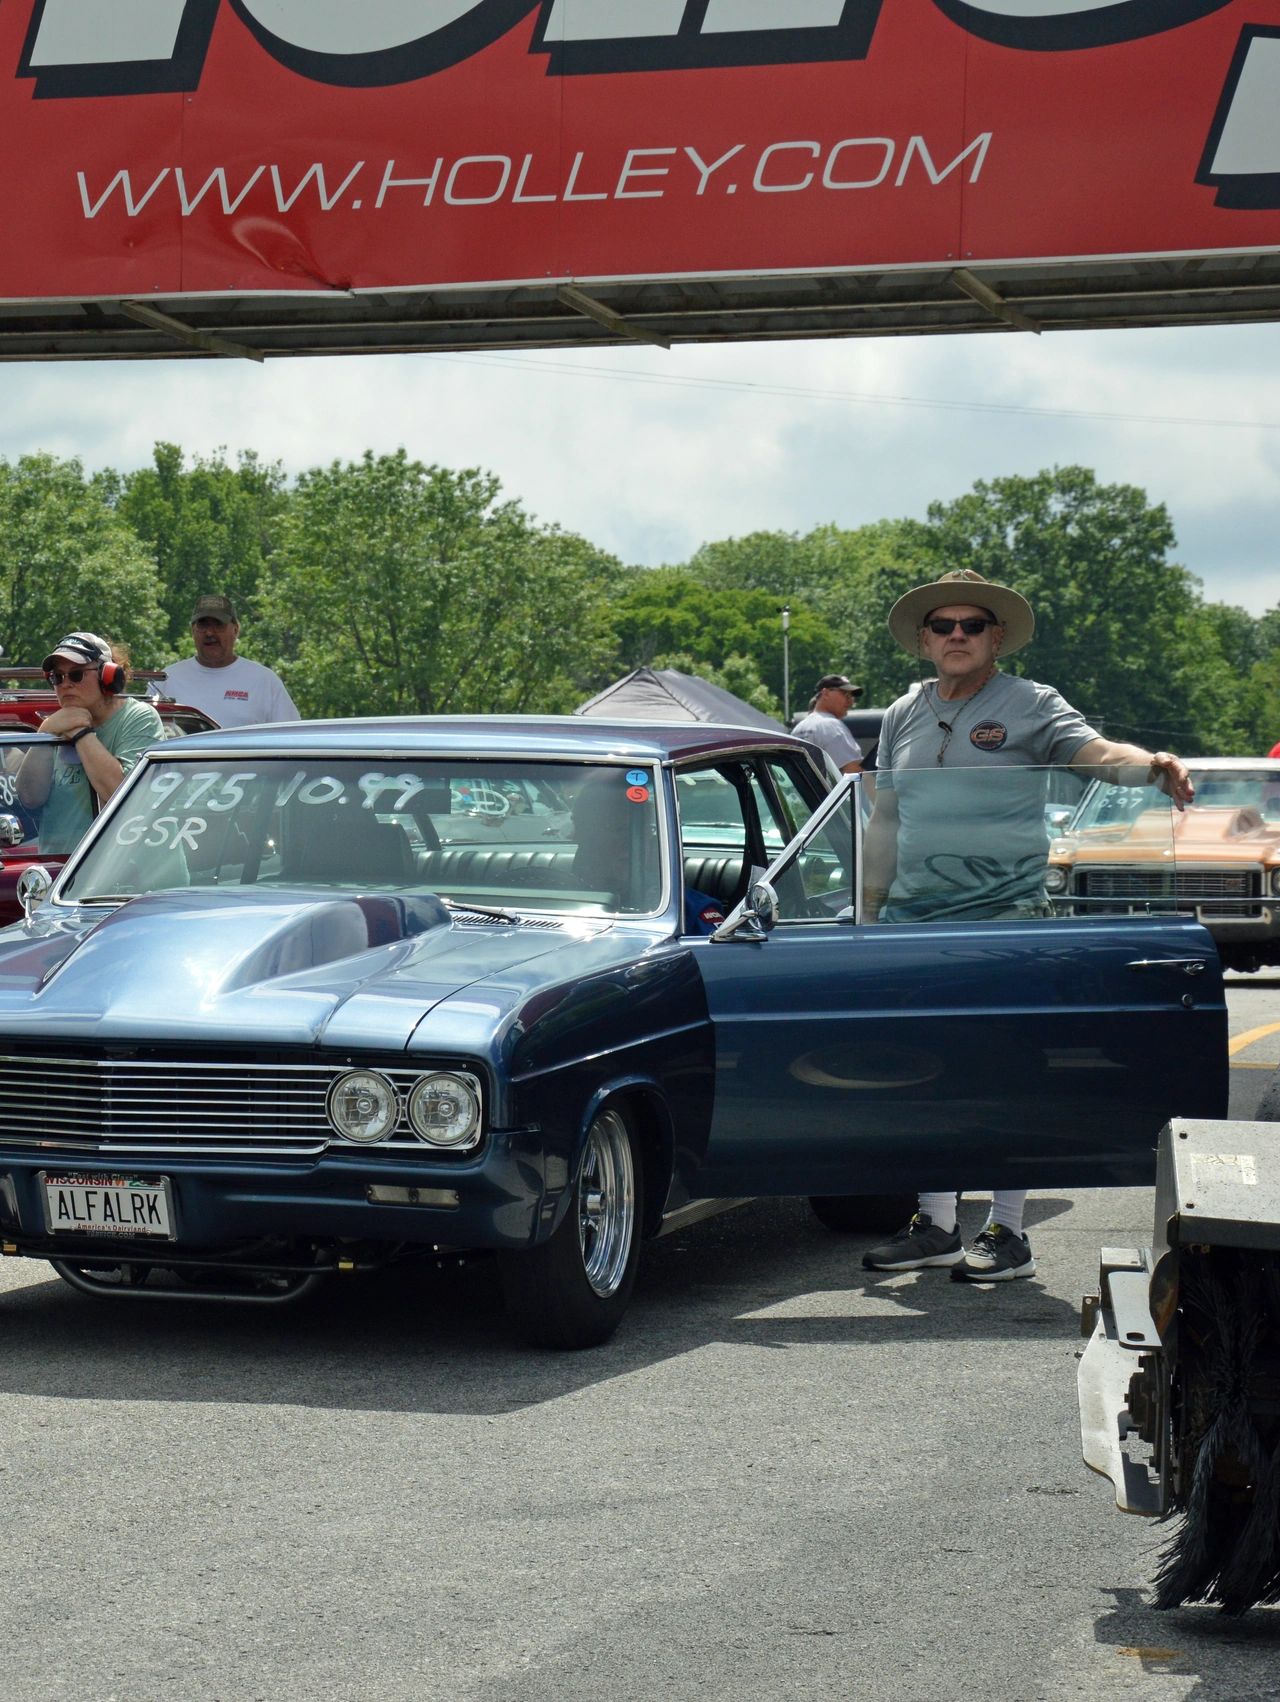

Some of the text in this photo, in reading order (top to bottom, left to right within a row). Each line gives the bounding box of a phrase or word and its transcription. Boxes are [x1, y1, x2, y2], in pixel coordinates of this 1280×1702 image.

[76, 132, 993, 218] WWW.HOLLEY.COM
[971, 728, 1006, 742] GS
[150, 772, 256, 811] 975
[115, 815, 207, 851] GSR
[45, 1176, 113, 1187] WISCONSIN
[58, 1190, 162, 1225] ALFALRK
[77, 1223, 146, 1233] America's Dairyland
